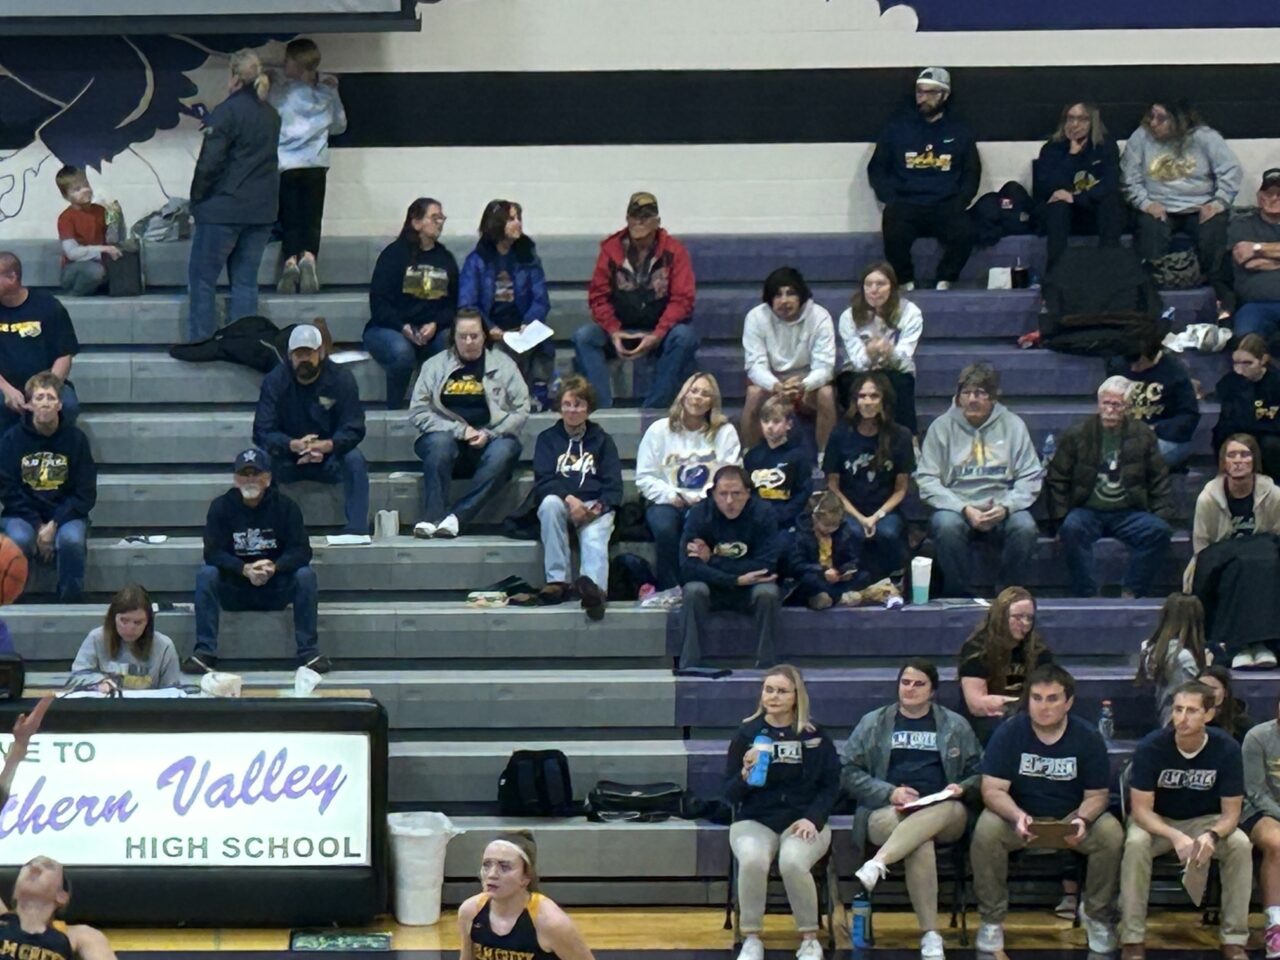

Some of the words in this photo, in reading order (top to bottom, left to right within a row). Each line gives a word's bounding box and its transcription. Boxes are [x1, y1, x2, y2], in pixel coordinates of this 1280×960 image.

[53, 740, 96, 763] TO
[156, 746, 348, 816] Valley
[125, 836, 208, 859] HIGH
[222, 836, 362, 859] SCHOOL
